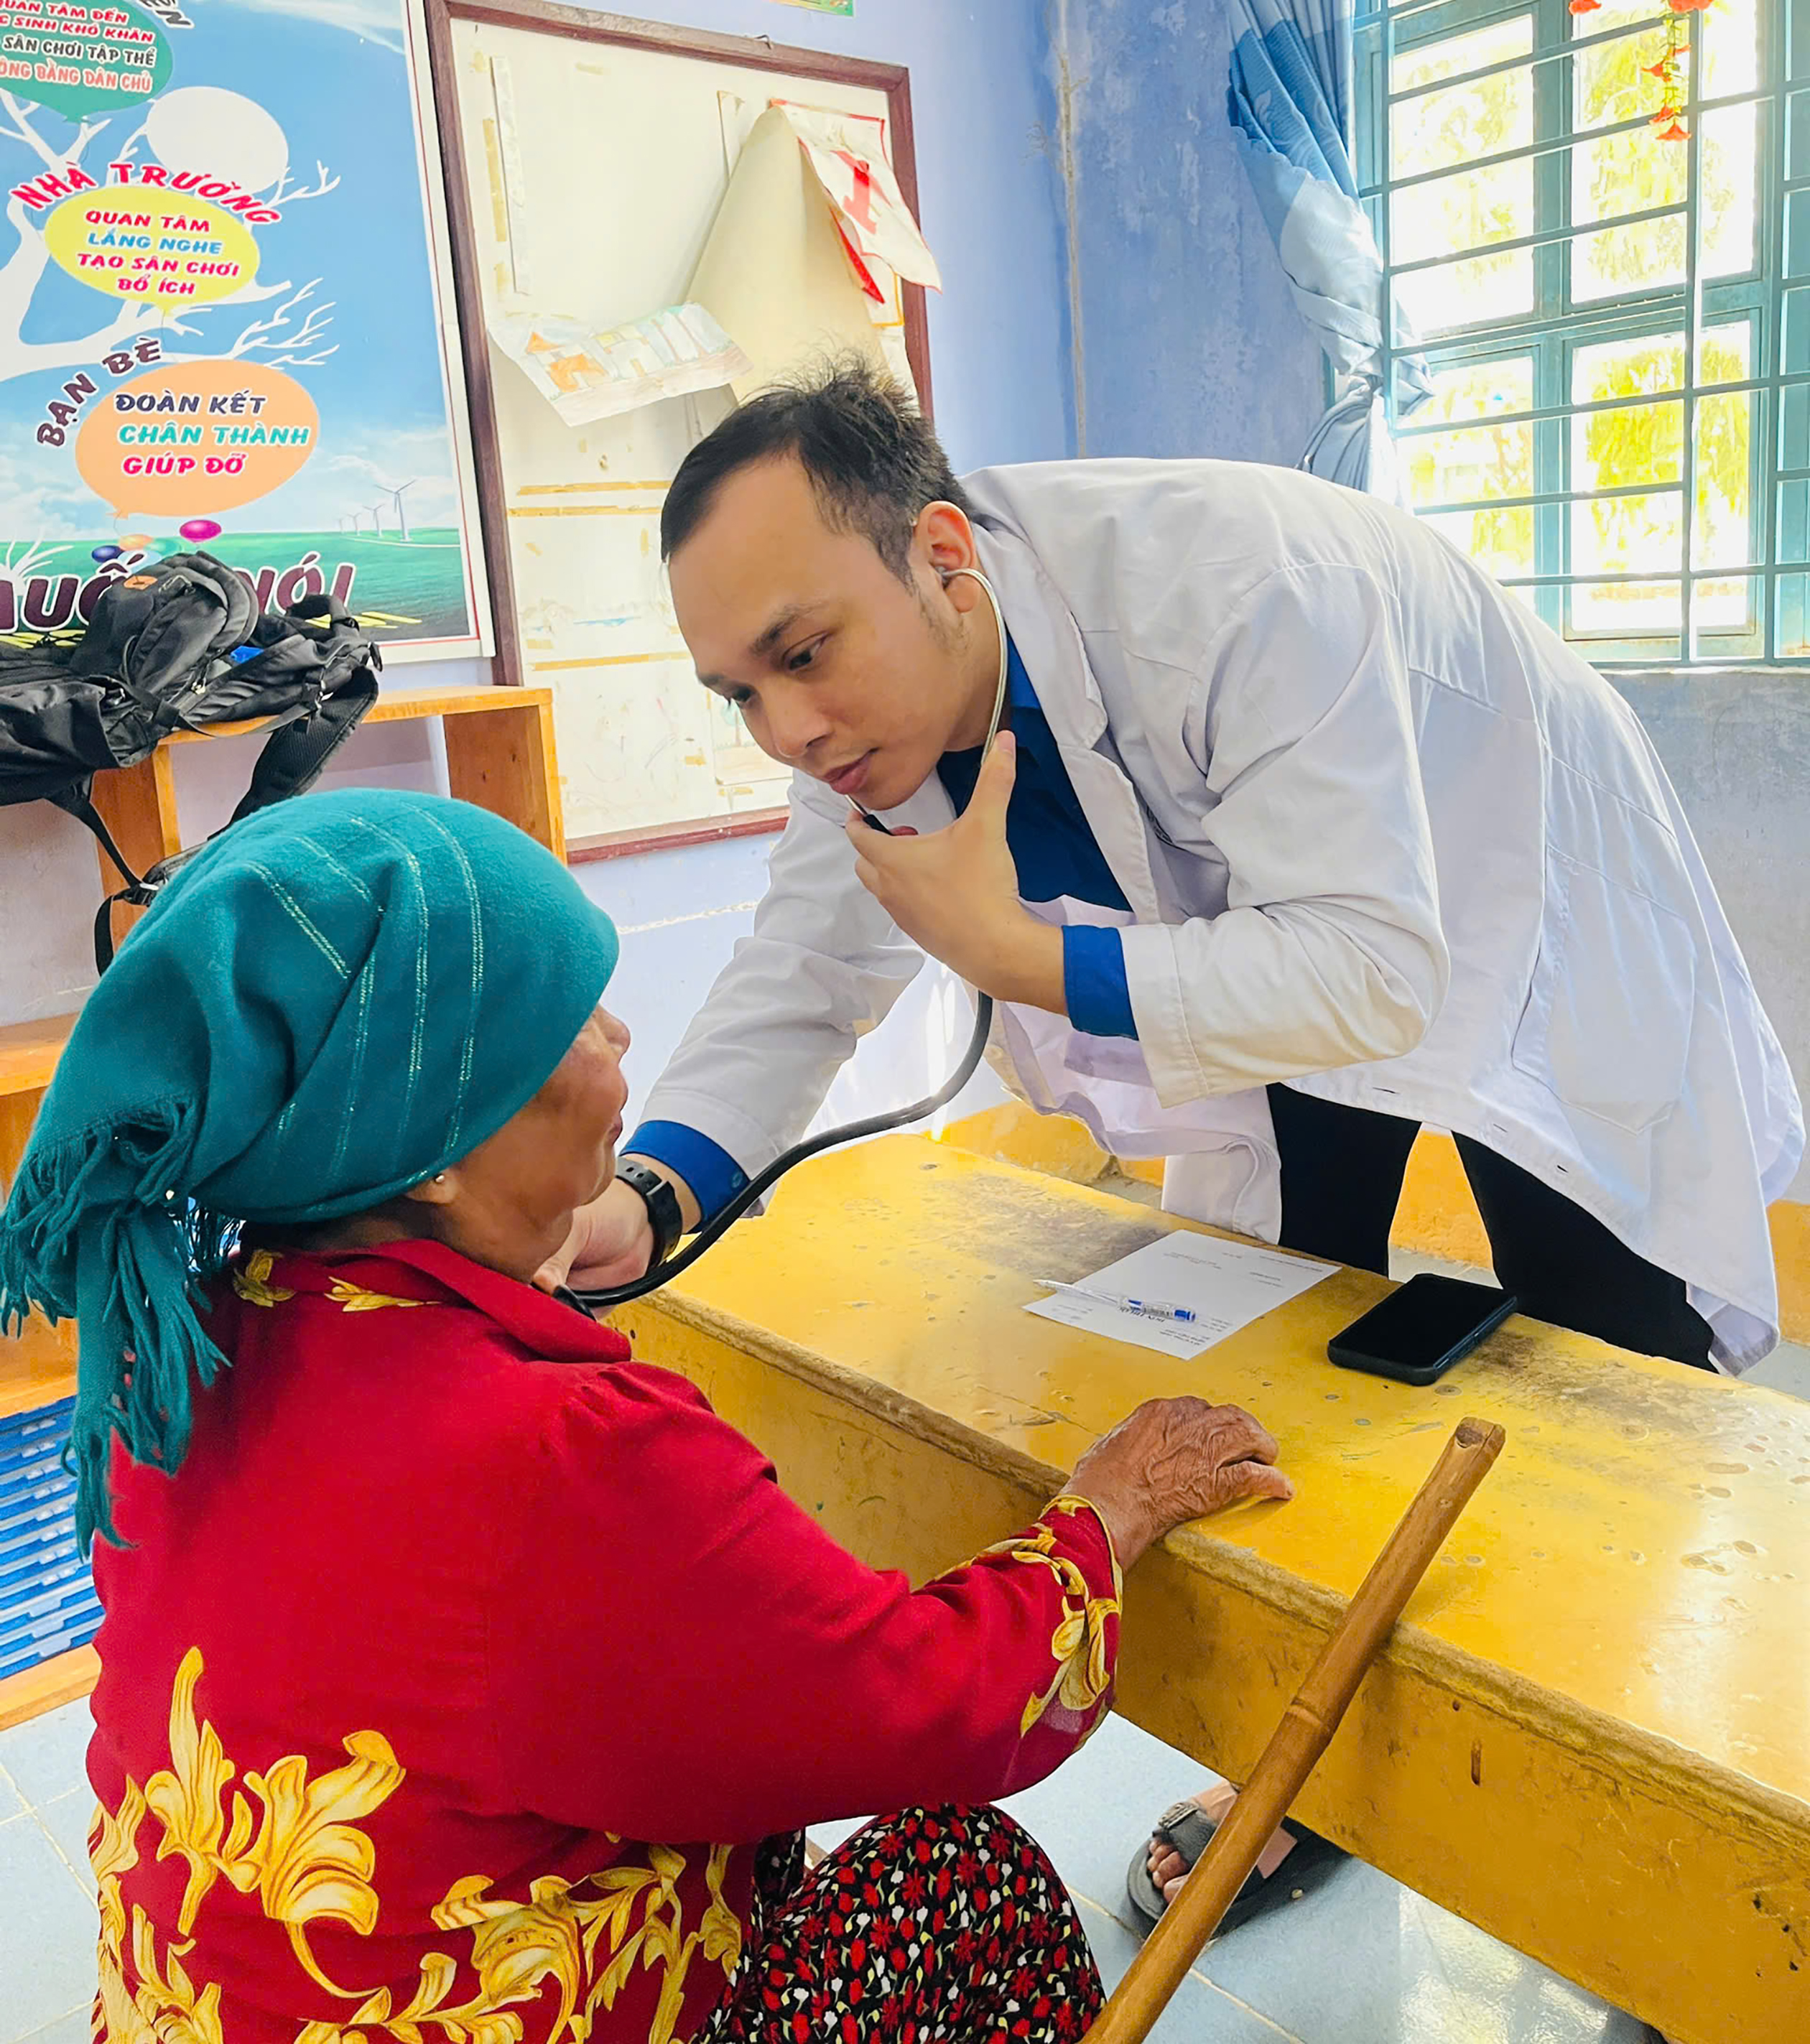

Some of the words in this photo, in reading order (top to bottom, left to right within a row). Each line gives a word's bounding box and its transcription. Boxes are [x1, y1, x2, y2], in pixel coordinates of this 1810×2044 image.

[48, 4, 85, 18] TÂM
[92, 8, 127, 24] ĐẾN
[14, 17, 57, 30] SINH
[62, 22, 98, 35] KHÓ
[4, 35, 37, 52] SÂN
[43, 42, 82, 57] CHƠI
[88, 45, 119, 62] TẬP
[124, 47, 155, 65] THỂ
[84, 68, 117, 88] DÂN
[122, 72, 151, 91] CHỦ
[11, 162, 96, 209] NHÀ
[110, 164, 280, 222] TRƯỜNG
[85, 210, 151, 228] QUAN
[160, 215, 210, 232] TÂM
[159, 238, 222, 254] NGHE
[78, 253, 124, 271] TẠO
[131, 256, 178, 272] SÂN
[186, 262, 239, 277] CHƠI
[158, 277, 195, 294] ÍCH
[37, 373, 97, 446] BẠN
[102, 338, 160, 373] BÈ
[116, 390, 200, 412] ĐOÀN
[209, 390, 266, 414] KẾT
[119, 422, 202, 444] CHÂN
[213, 423, 309, 445] THÀNH
[124, 452, 195, 474] GIÚP
[205, 452, 246, 474] ĐỠ
